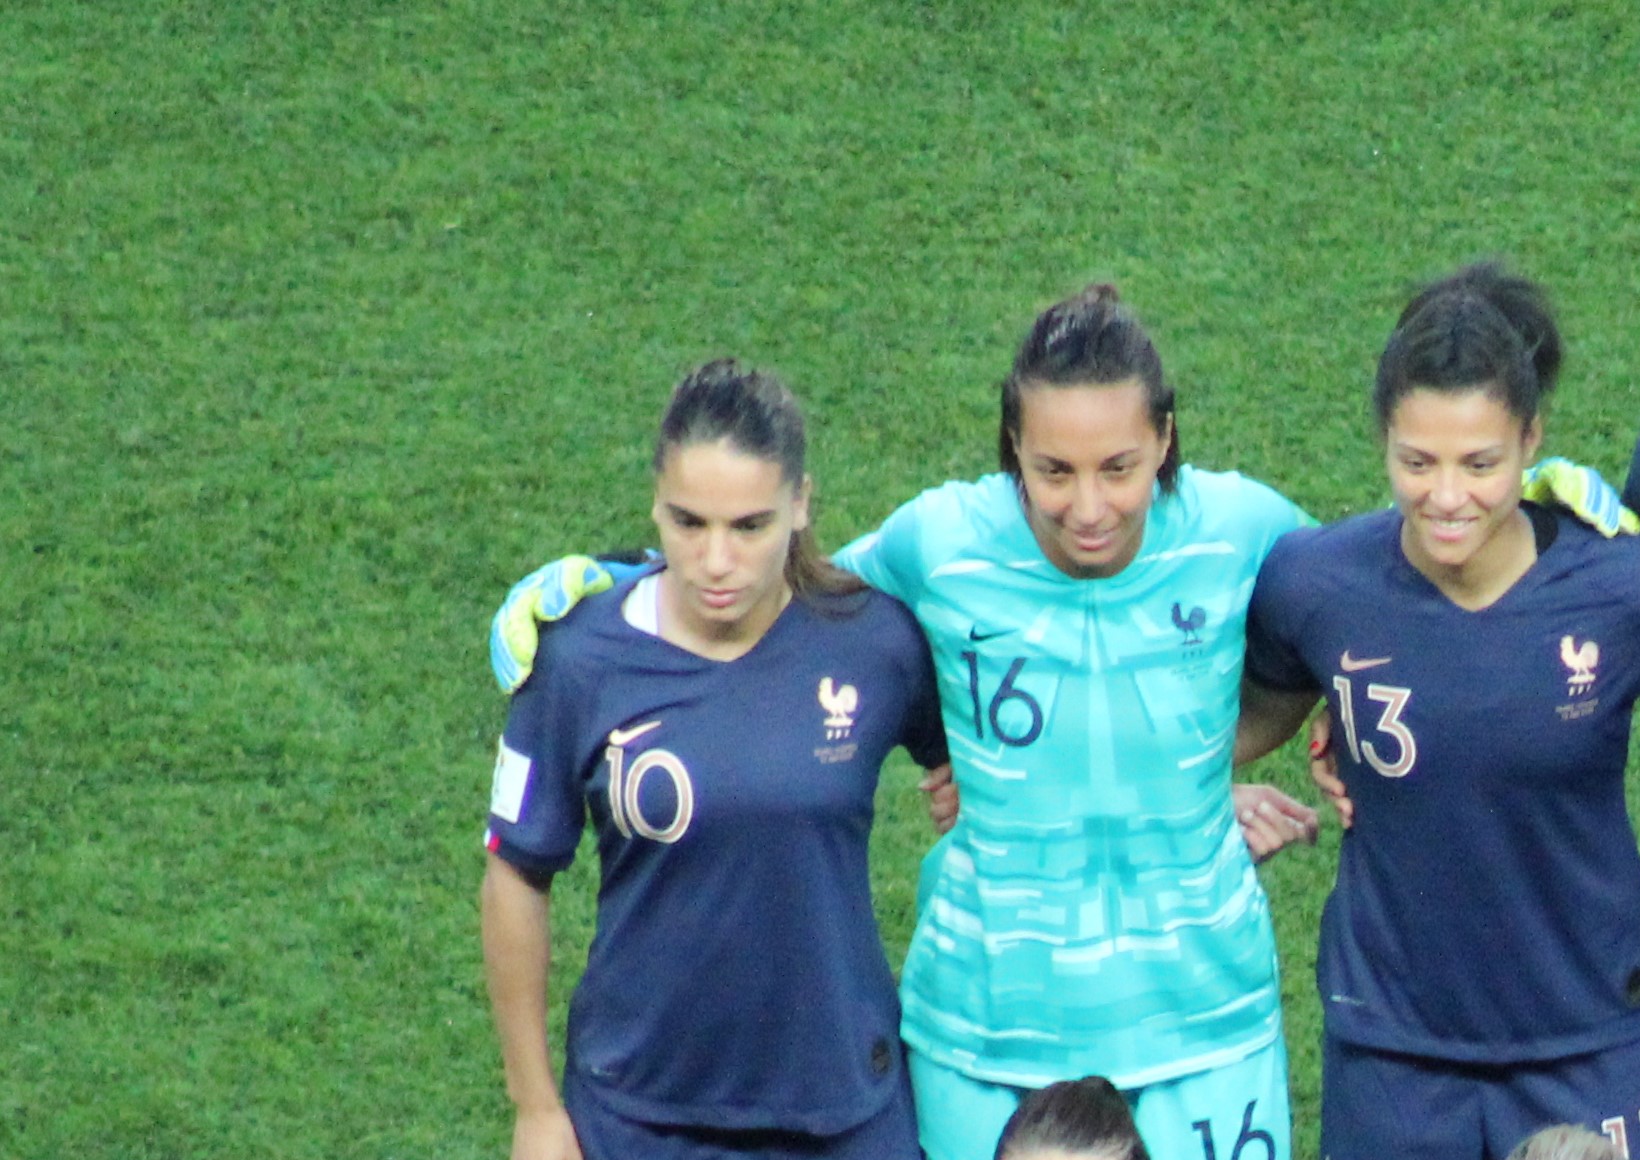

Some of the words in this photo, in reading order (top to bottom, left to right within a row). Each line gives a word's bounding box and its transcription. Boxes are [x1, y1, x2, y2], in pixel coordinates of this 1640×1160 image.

[960, 649, 1044, 748] 16
[1332, 674, 1417, 778] 13
[605, 745, 694, 844] 10
